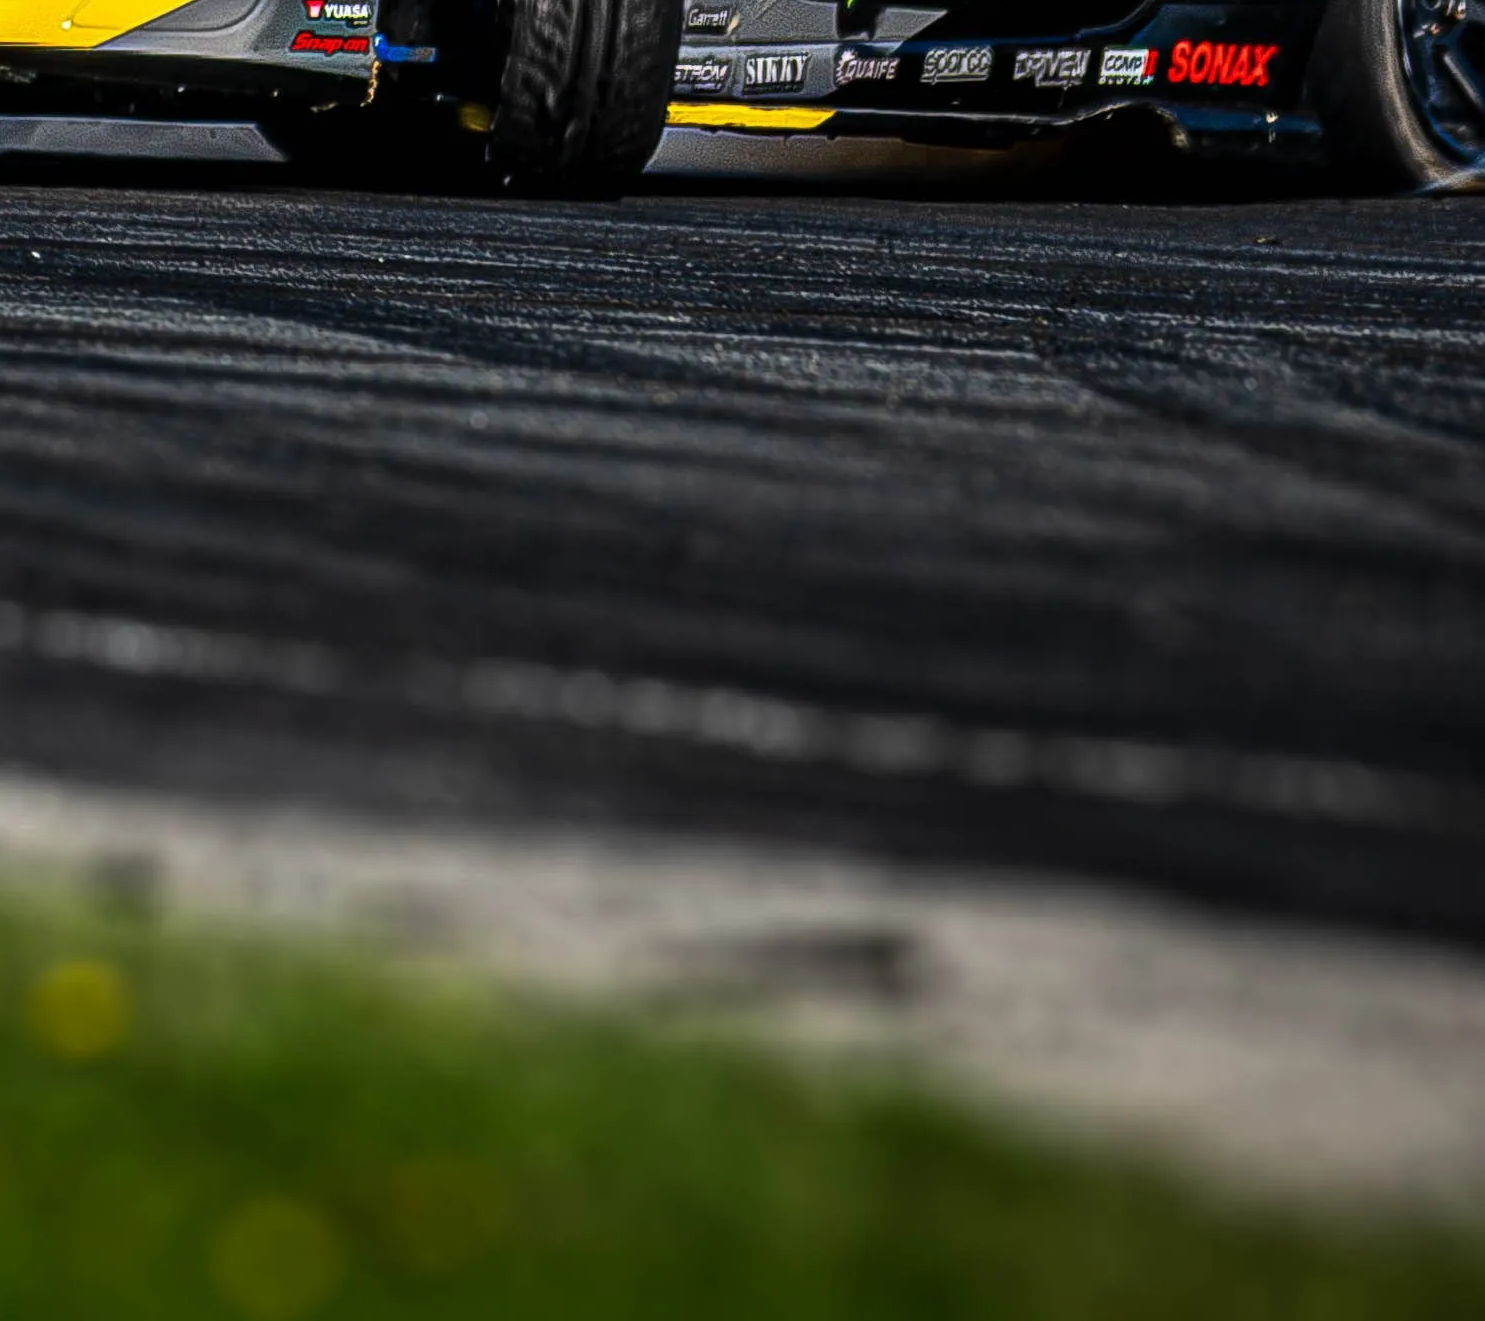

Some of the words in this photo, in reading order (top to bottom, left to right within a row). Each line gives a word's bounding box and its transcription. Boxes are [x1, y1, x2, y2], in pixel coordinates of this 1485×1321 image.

[324, 4, 371, 19] YUASA
[687, 9, 728, 28] Garrett
[846, 58, 901, 81] QUAIFE
[1167, 39, 1277, 87] SONAX
